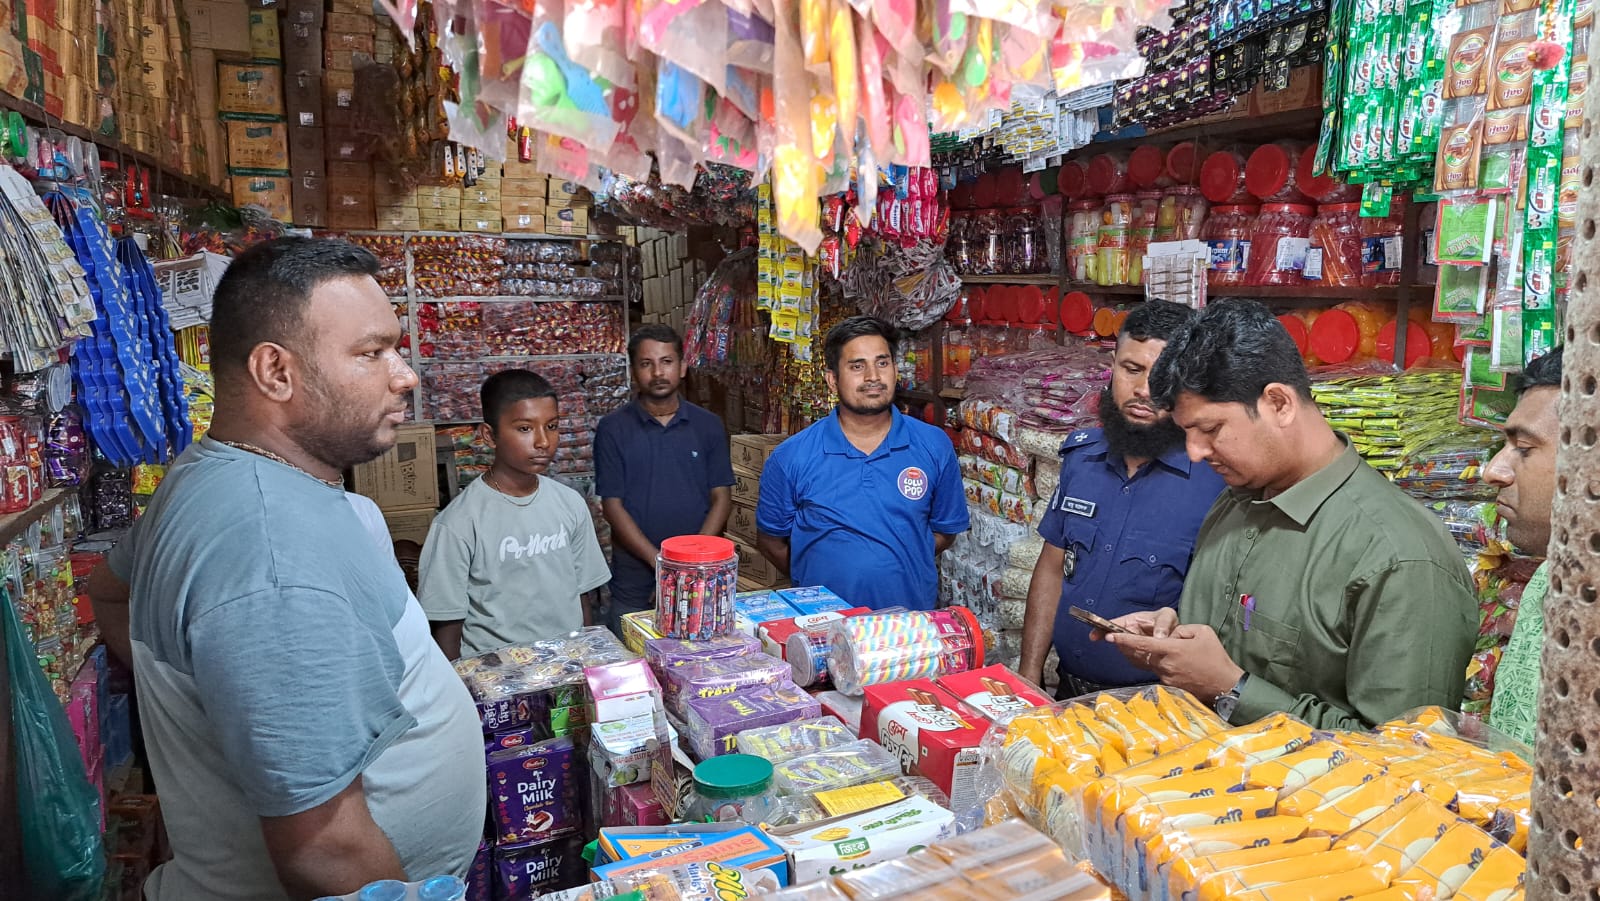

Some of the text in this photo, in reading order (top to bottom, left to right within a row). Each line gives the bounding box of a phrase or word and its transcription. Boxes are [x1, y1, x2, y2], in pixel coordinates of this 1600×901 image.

[905, 485, 923, 497] POP
[517, 778, 557, 793] Dairy
[522, 789, 554, 805] Milk
[838, 840, 867, 856] জিংক
[526, 856, 563, 874] Dairy
[530, 867, 560, 883] Milk
